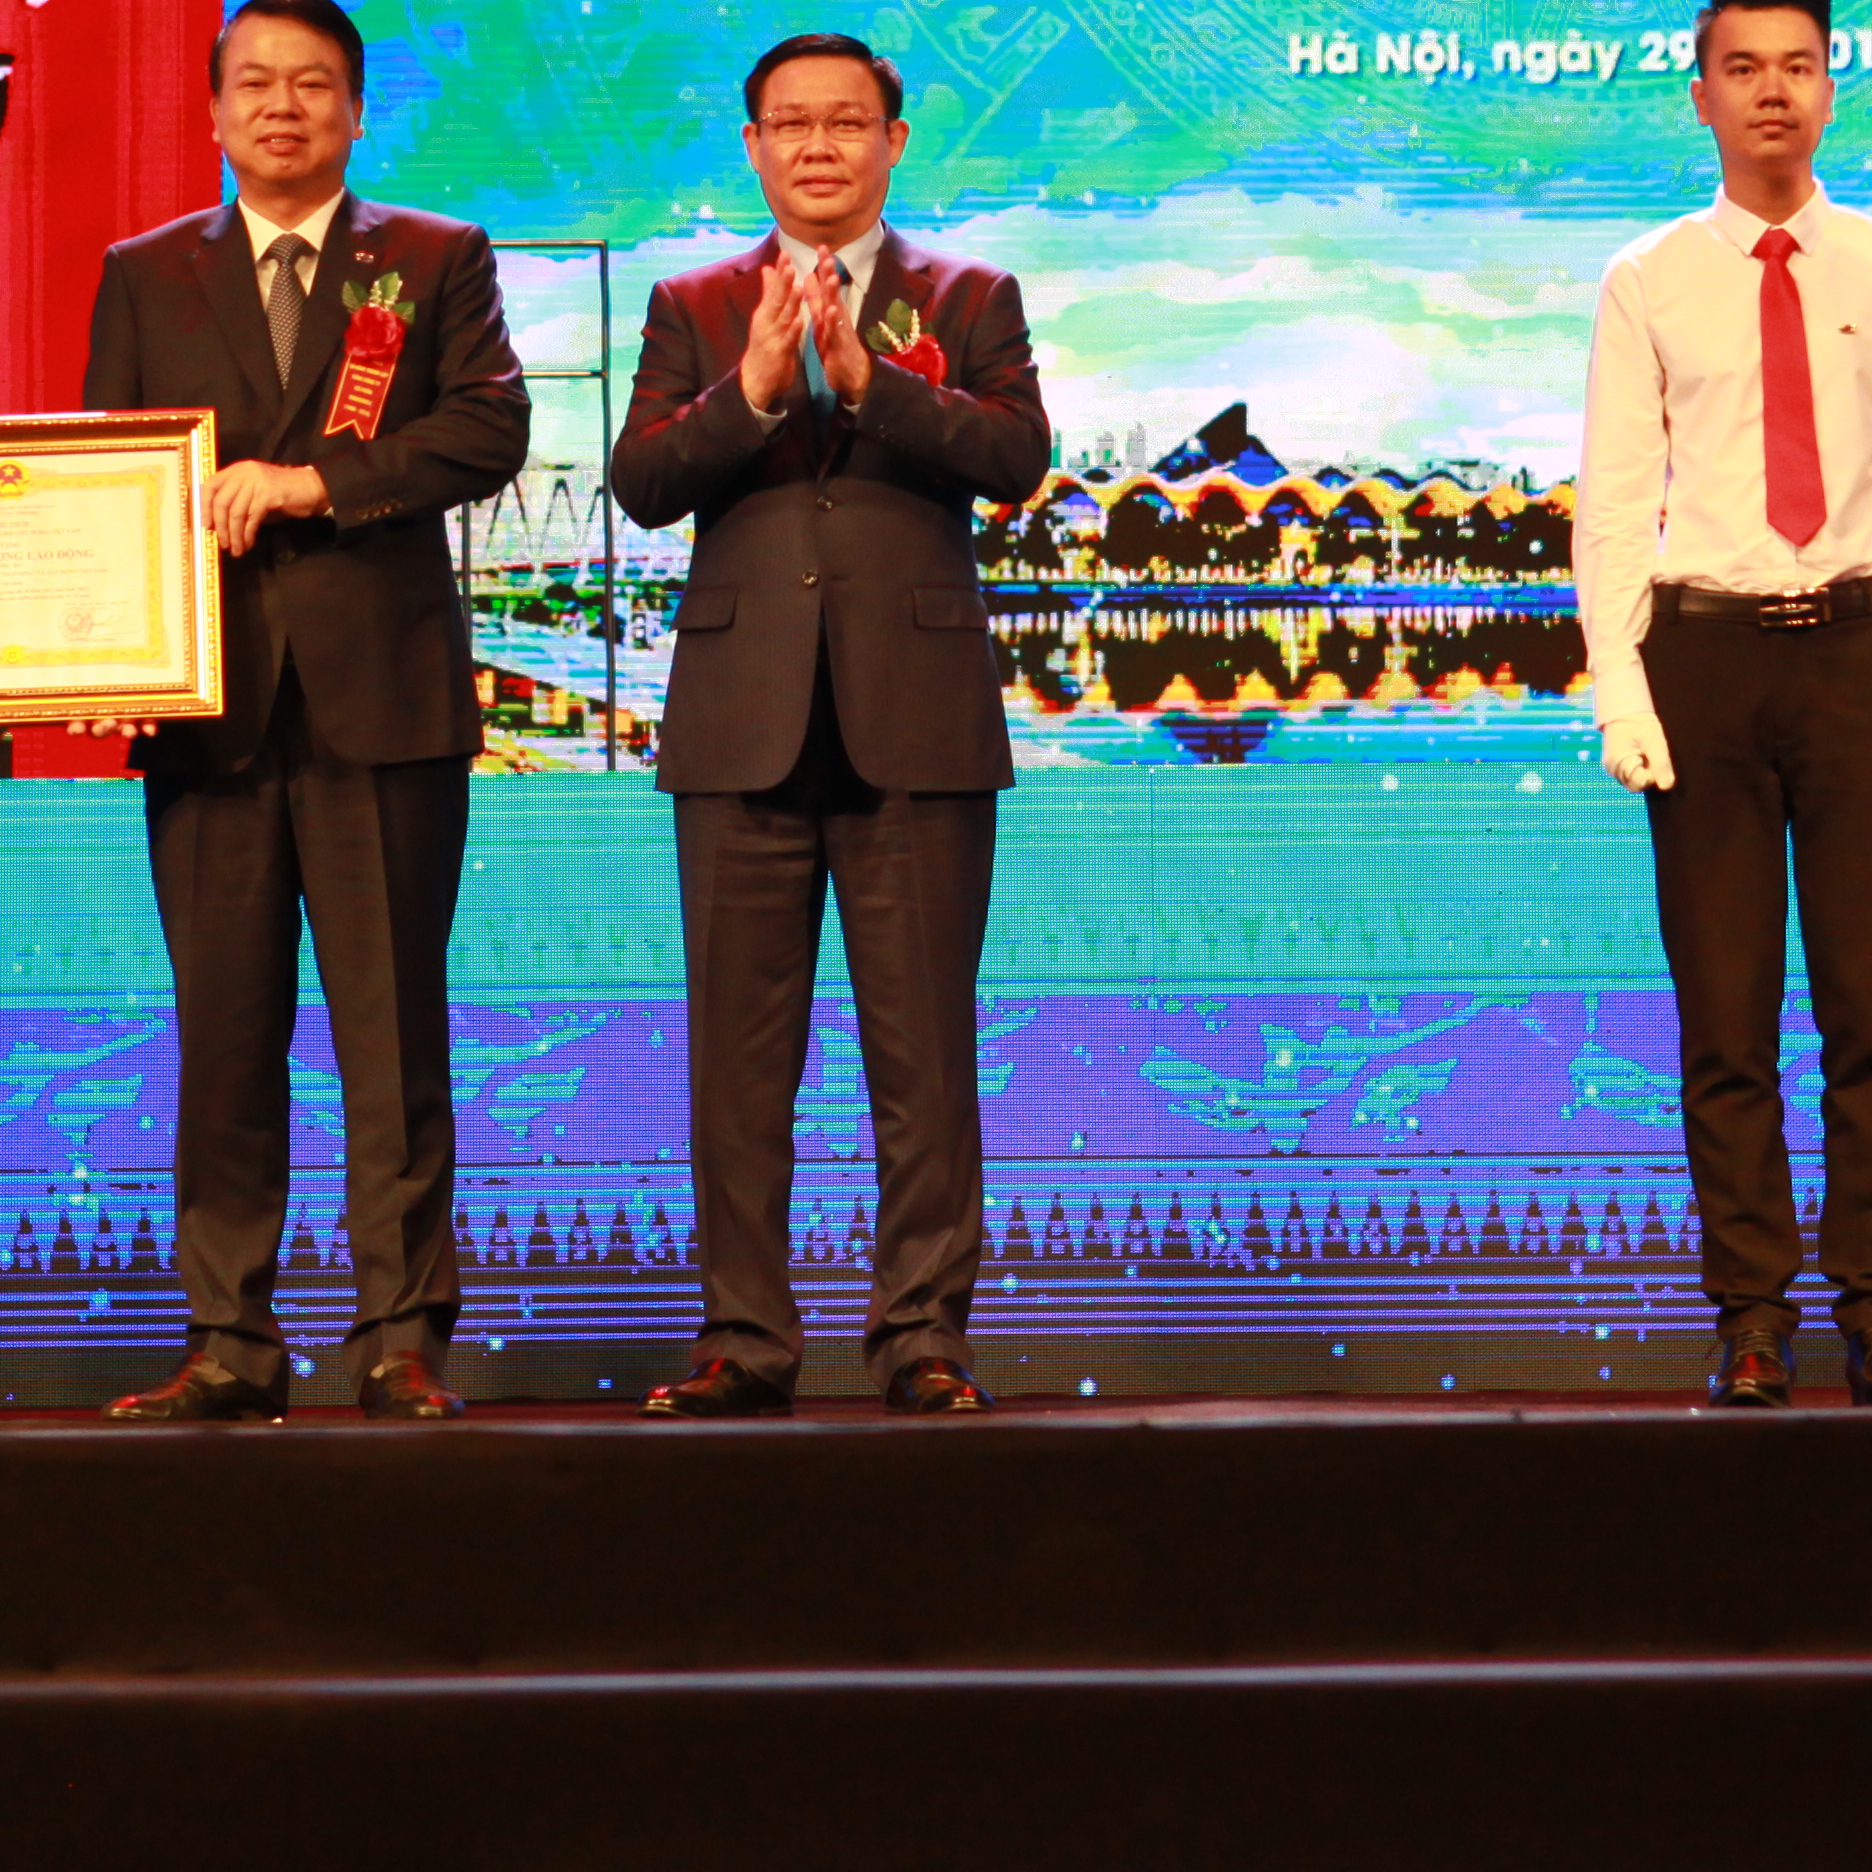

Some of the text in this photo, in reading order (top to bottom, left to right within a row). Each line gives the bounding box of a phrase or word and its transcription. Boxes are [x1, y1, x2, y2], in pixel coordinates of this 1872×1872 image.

[1290, 35, 1357, 73] Hà
[1378, 31, 1472, 78] Nội,
[1494, 41, 1620, 82] ngày
[27, 550, 53, 561] LAO
[57, 548, 95, 560] ĐỘNG
